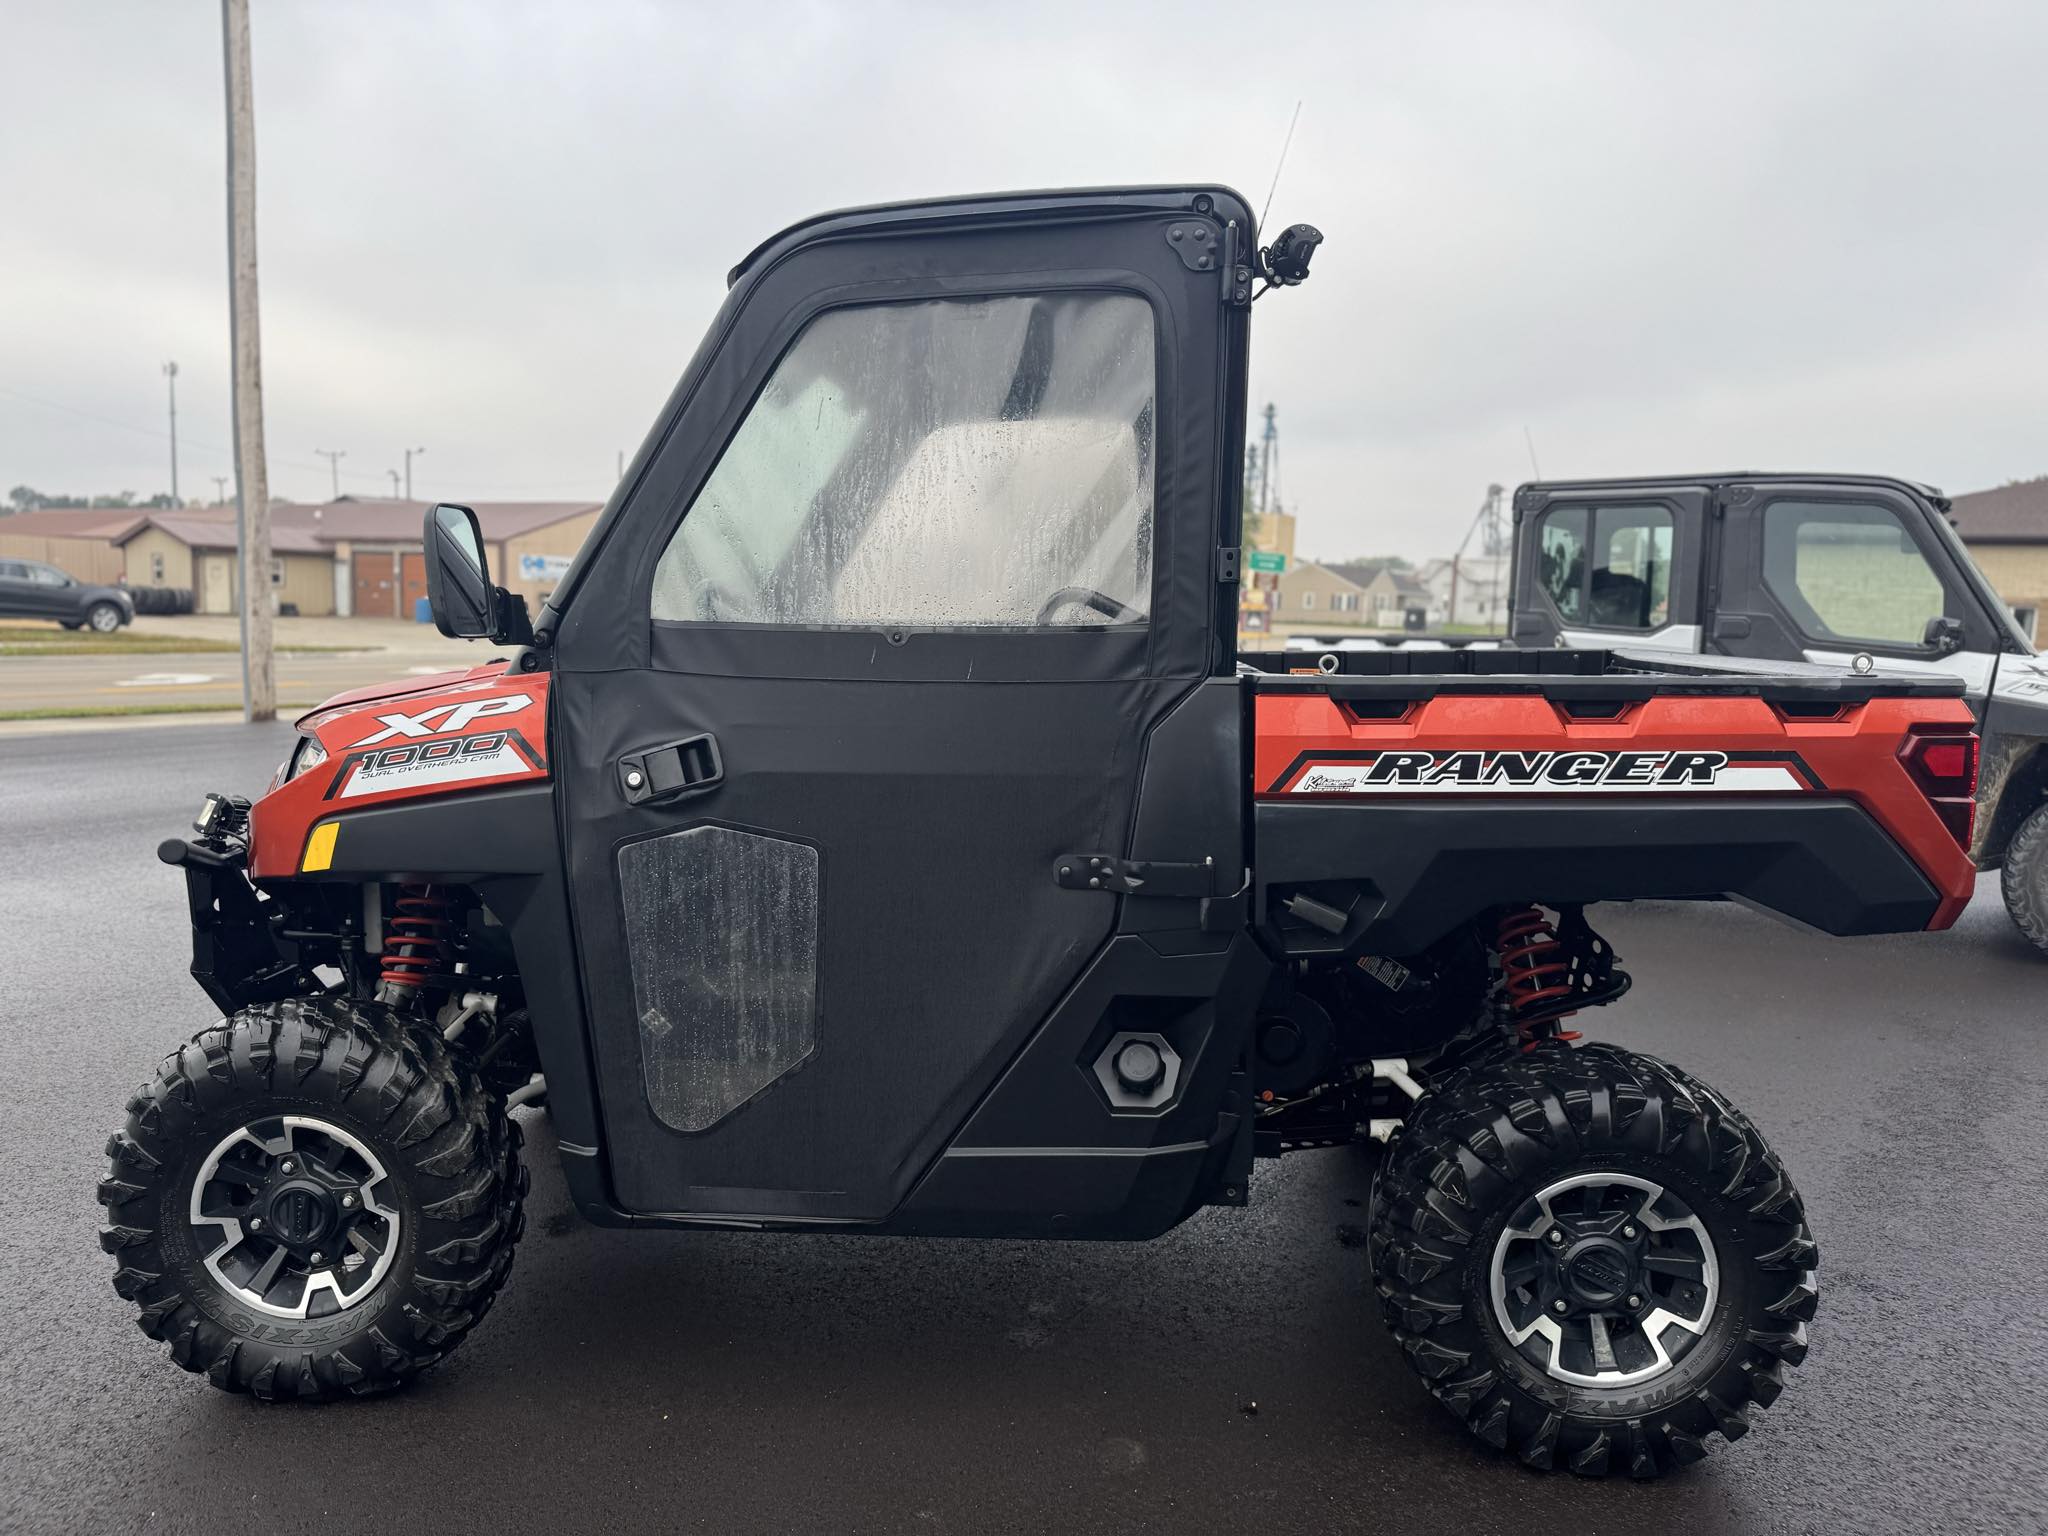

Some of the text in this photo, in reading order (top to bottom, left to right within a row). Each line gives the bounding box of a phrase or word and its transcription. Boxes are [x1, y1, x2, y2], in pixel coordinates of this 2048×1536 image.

[338, 693, 535, 751] XP
[360, 732, 508, 773] 1000
[361, 753, 501, 780] DUAL OVERHEAD CAM
[1361, 750, 1728, 785] RANGER
[228, 1288, 388, 1343] MAXXIS
[1498, 1358, 1676, 1417] MAXXIS
